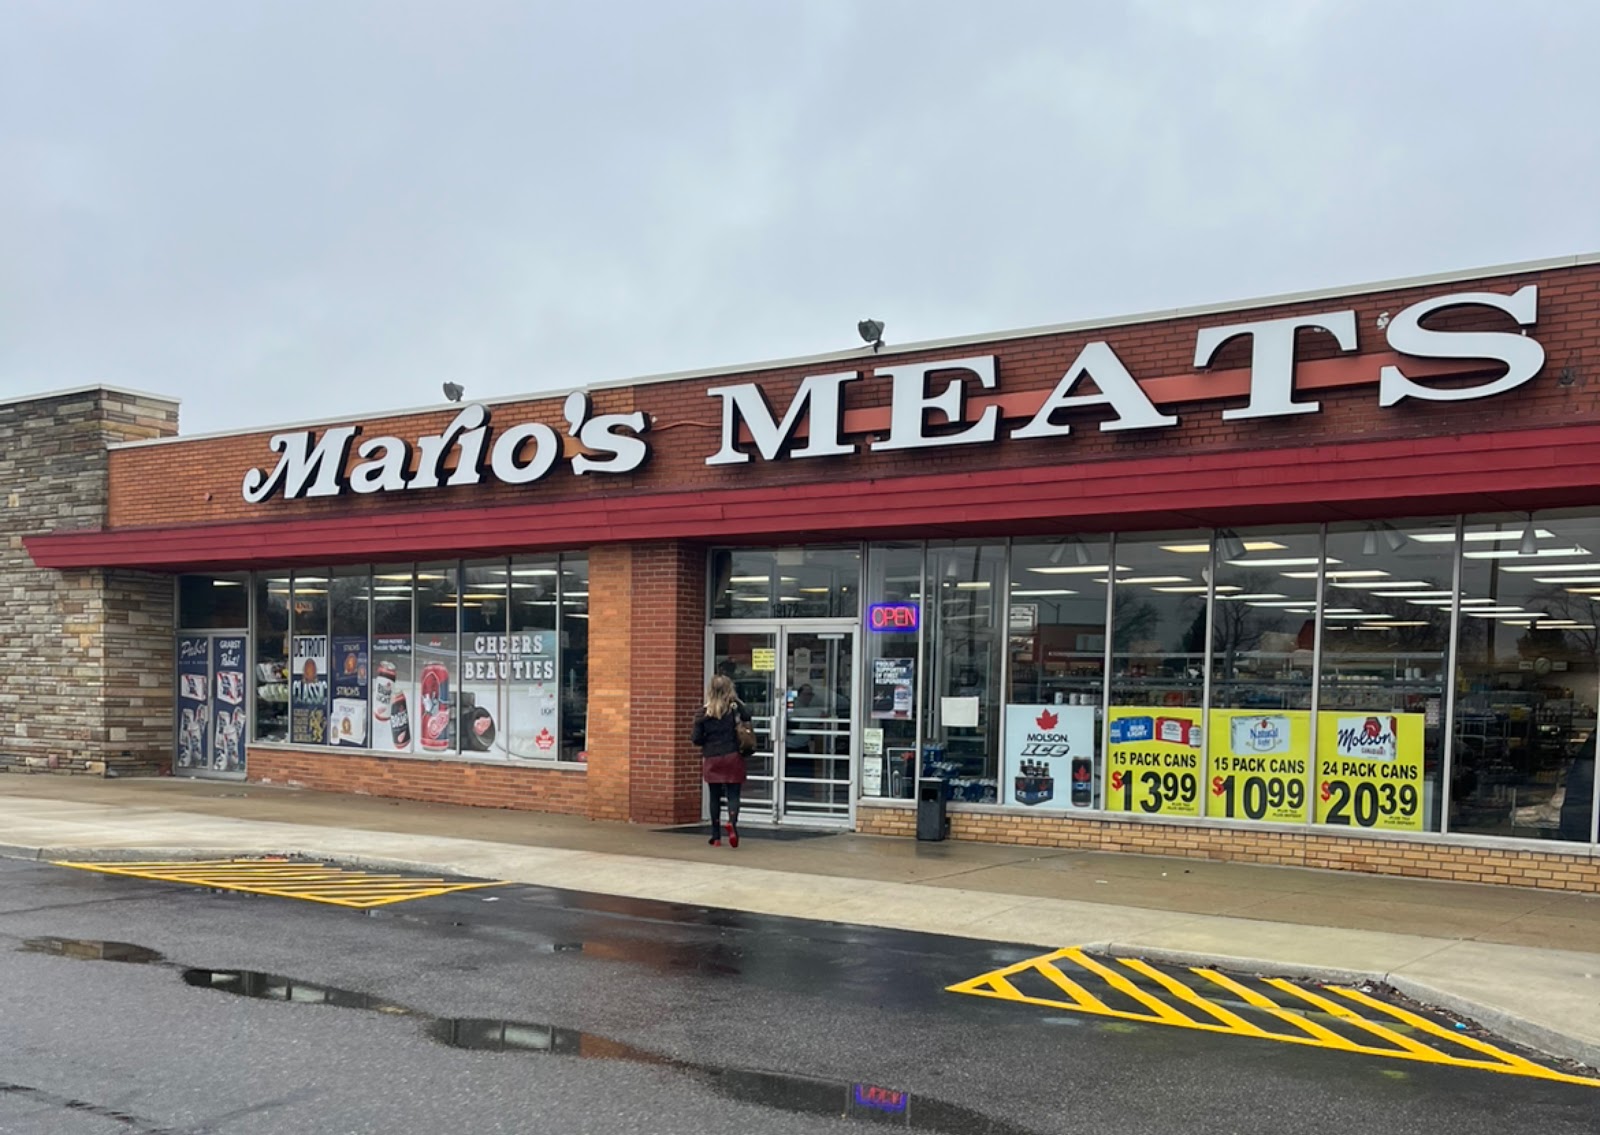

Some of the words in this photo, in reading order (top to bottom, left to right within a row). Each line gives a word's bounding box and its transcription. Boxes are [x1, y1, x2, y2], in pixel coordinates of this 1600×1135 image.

[242, 390, 650, 504] Mario's
[704, 284, 1546, 466] MEATS
[871, 606, 916, 628] OPEN
[293, 637, 326, 658] DETROIT
[474, 635, 544, 655] CHEERS
[463, 660, 554, 680] BEAUTIES
[293, 680, 327, 705] CLASSIC
[1027, 733, 1068, 742] MOLSON
[1249, 727, 1280, 740] Natural
[1336, 727, 1392, 753] Molson
[1113, 751, 1126, 766] 15
[1130, 752, 1160, 767] PACK
[1164, 753, 1197, 768] CANS
[1214, 756, 1229, 771] 15
[1232, 758, 1266, 773] PACK
[1270, 759, 1305, 774] CANS
[1322, 761, 1338, 776] 24
[1342, 762, 1377, 778] PACK
[1381, 764, 1418, 780] CANS
